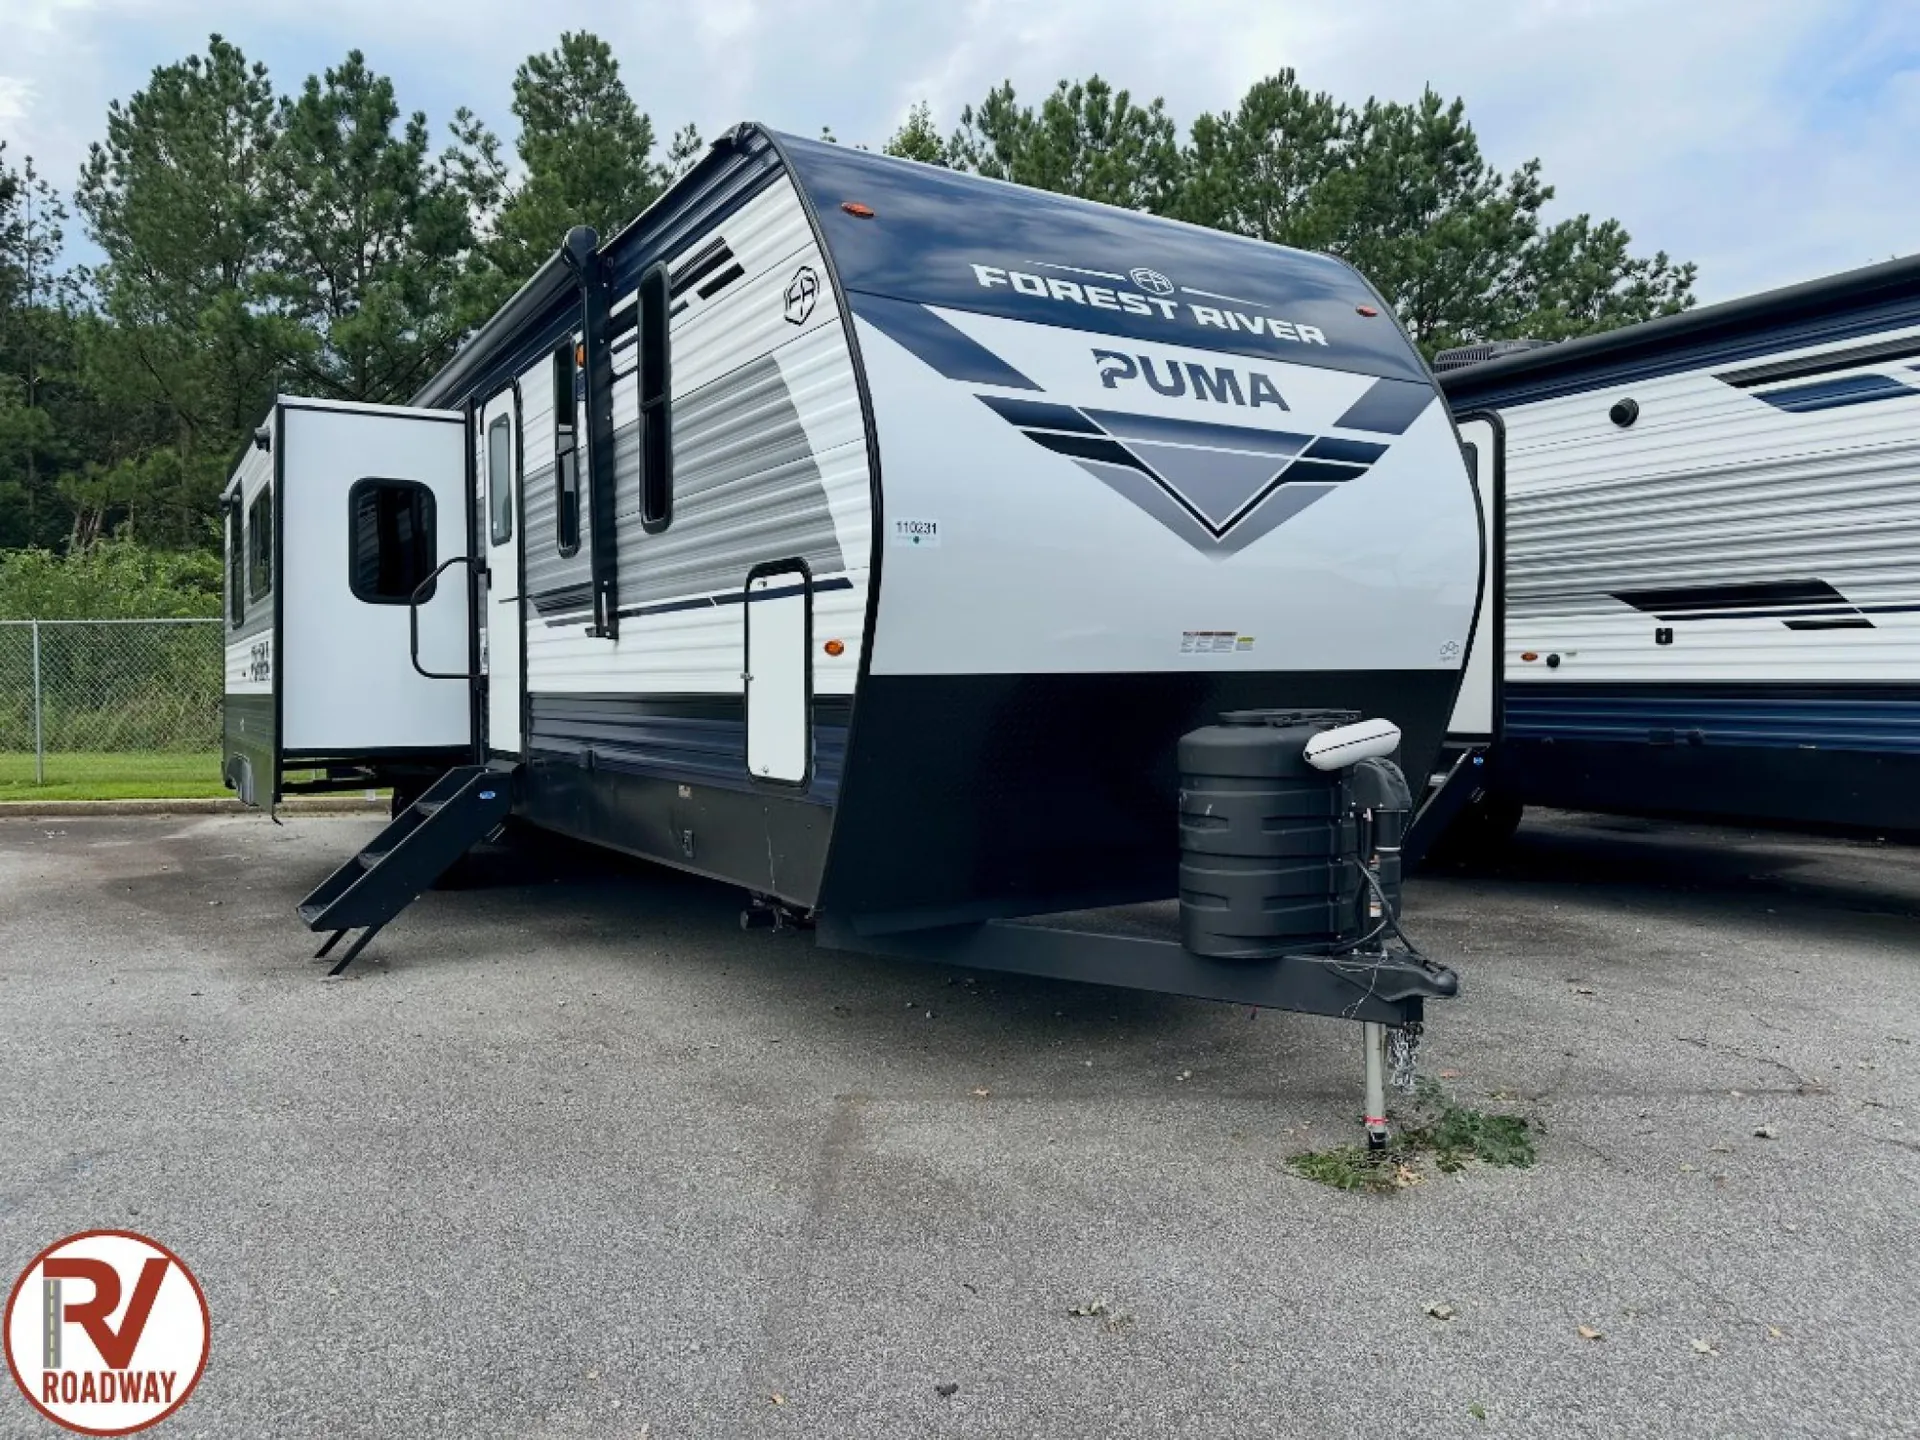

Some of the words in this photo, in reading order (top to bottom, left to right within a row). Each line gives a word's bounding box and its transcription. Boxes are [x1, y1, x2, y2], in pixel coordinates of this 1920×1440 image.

[970, 263, 1178, 320] FOREST
[1186, 303, 1329, 347] RIVER
[1091, 348, 1291, 412] PUMA
